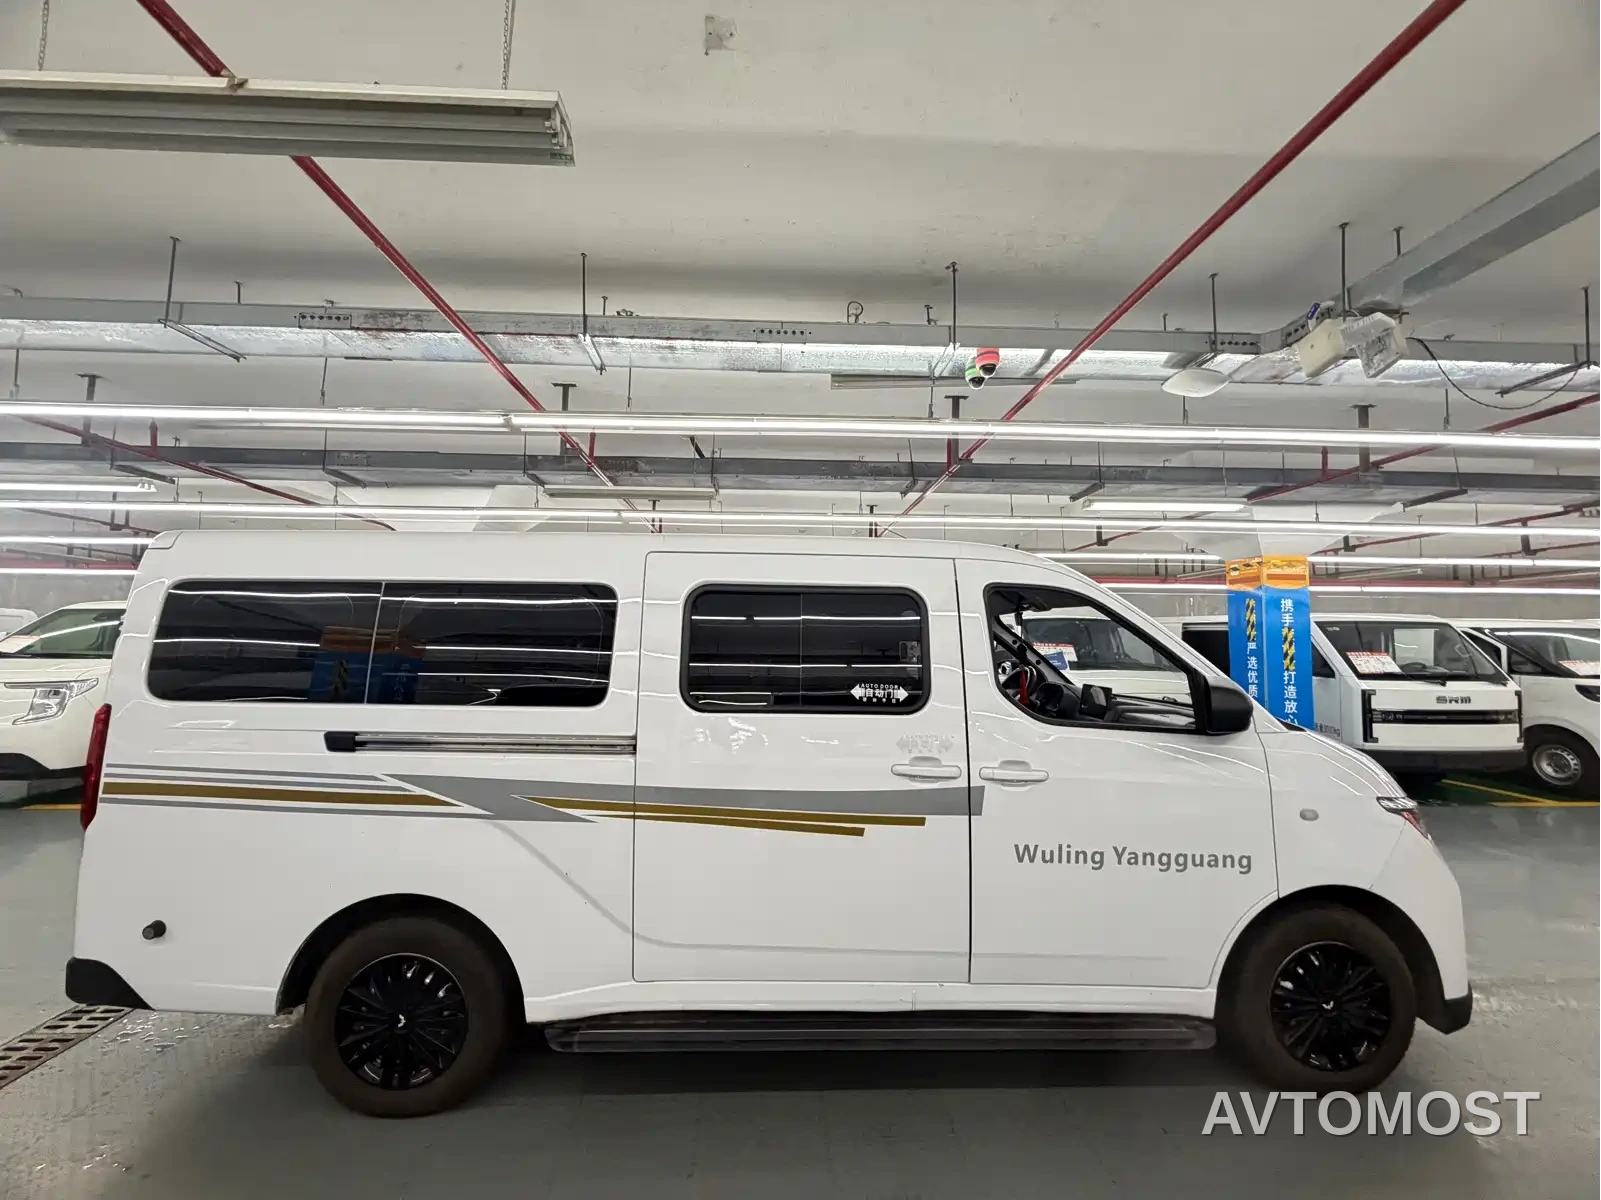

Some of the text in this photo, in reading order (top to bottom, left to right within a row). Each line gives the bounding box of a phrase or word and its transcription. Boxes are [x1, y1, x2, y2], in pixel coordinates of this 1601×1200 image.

[1281, 598, 1299, 725] 携手打造放心
[865, 688, 893, 698] 自动门
[1013, 844, 1252, 875] Wuling Yangguang
